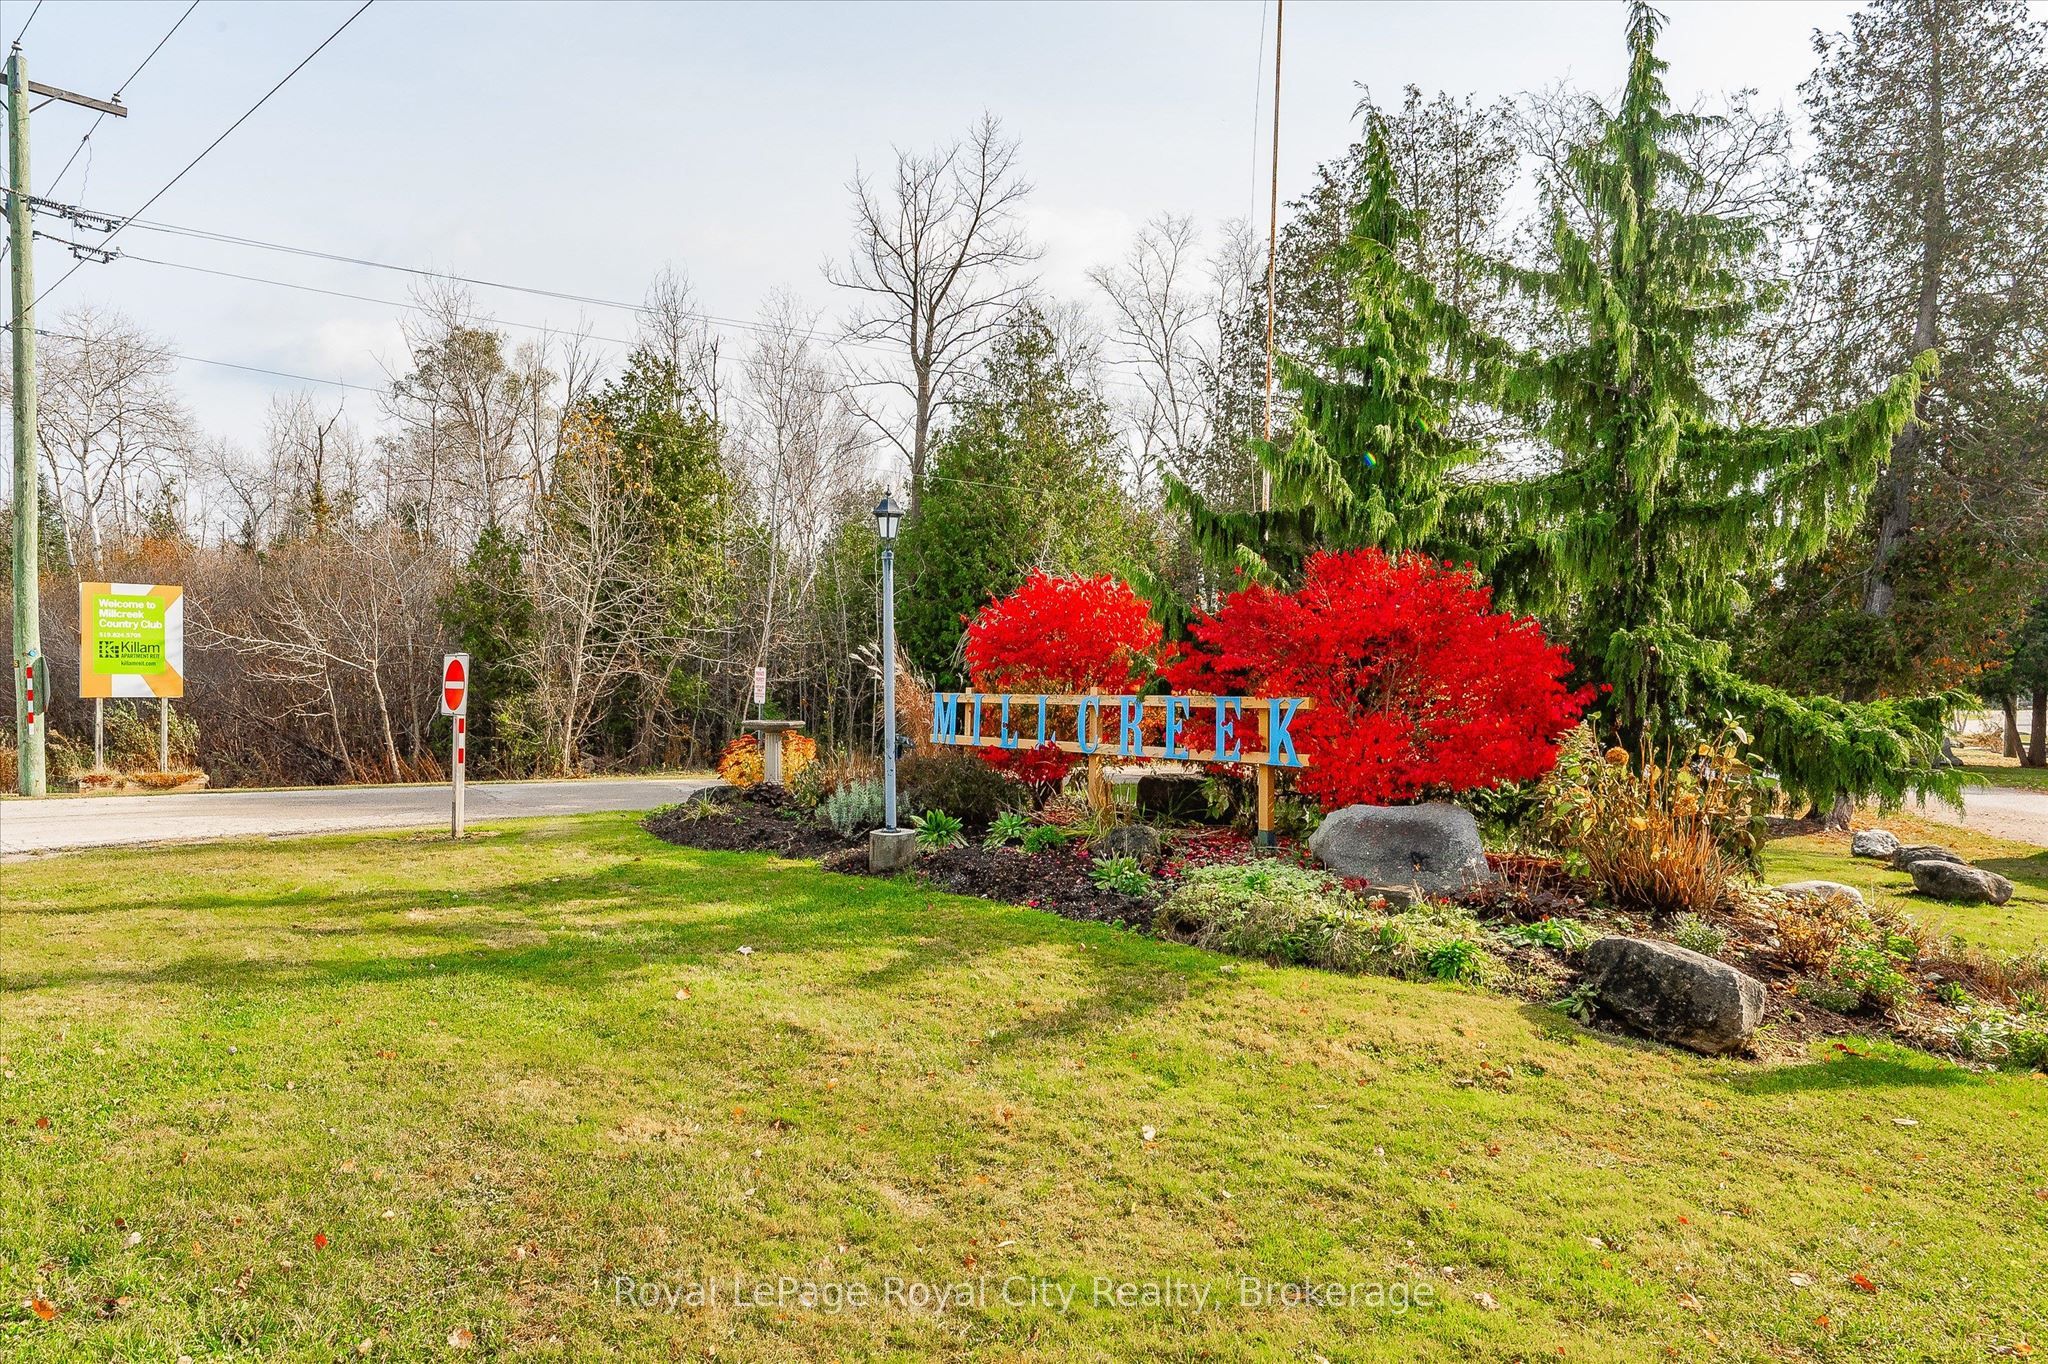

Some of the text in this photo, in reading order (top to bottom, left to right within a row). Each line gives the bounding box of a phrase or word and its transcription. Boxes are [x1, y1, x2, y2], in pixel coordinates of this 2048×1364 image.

[98, 599, 156, 609] Welcome to
[98, 609, 144, 618] Millcreek
[98, 619, 162, 630] Country Club
[121, 641, 160, 653] Killam
[932, 692, 1304, 767] MILLCREEK
